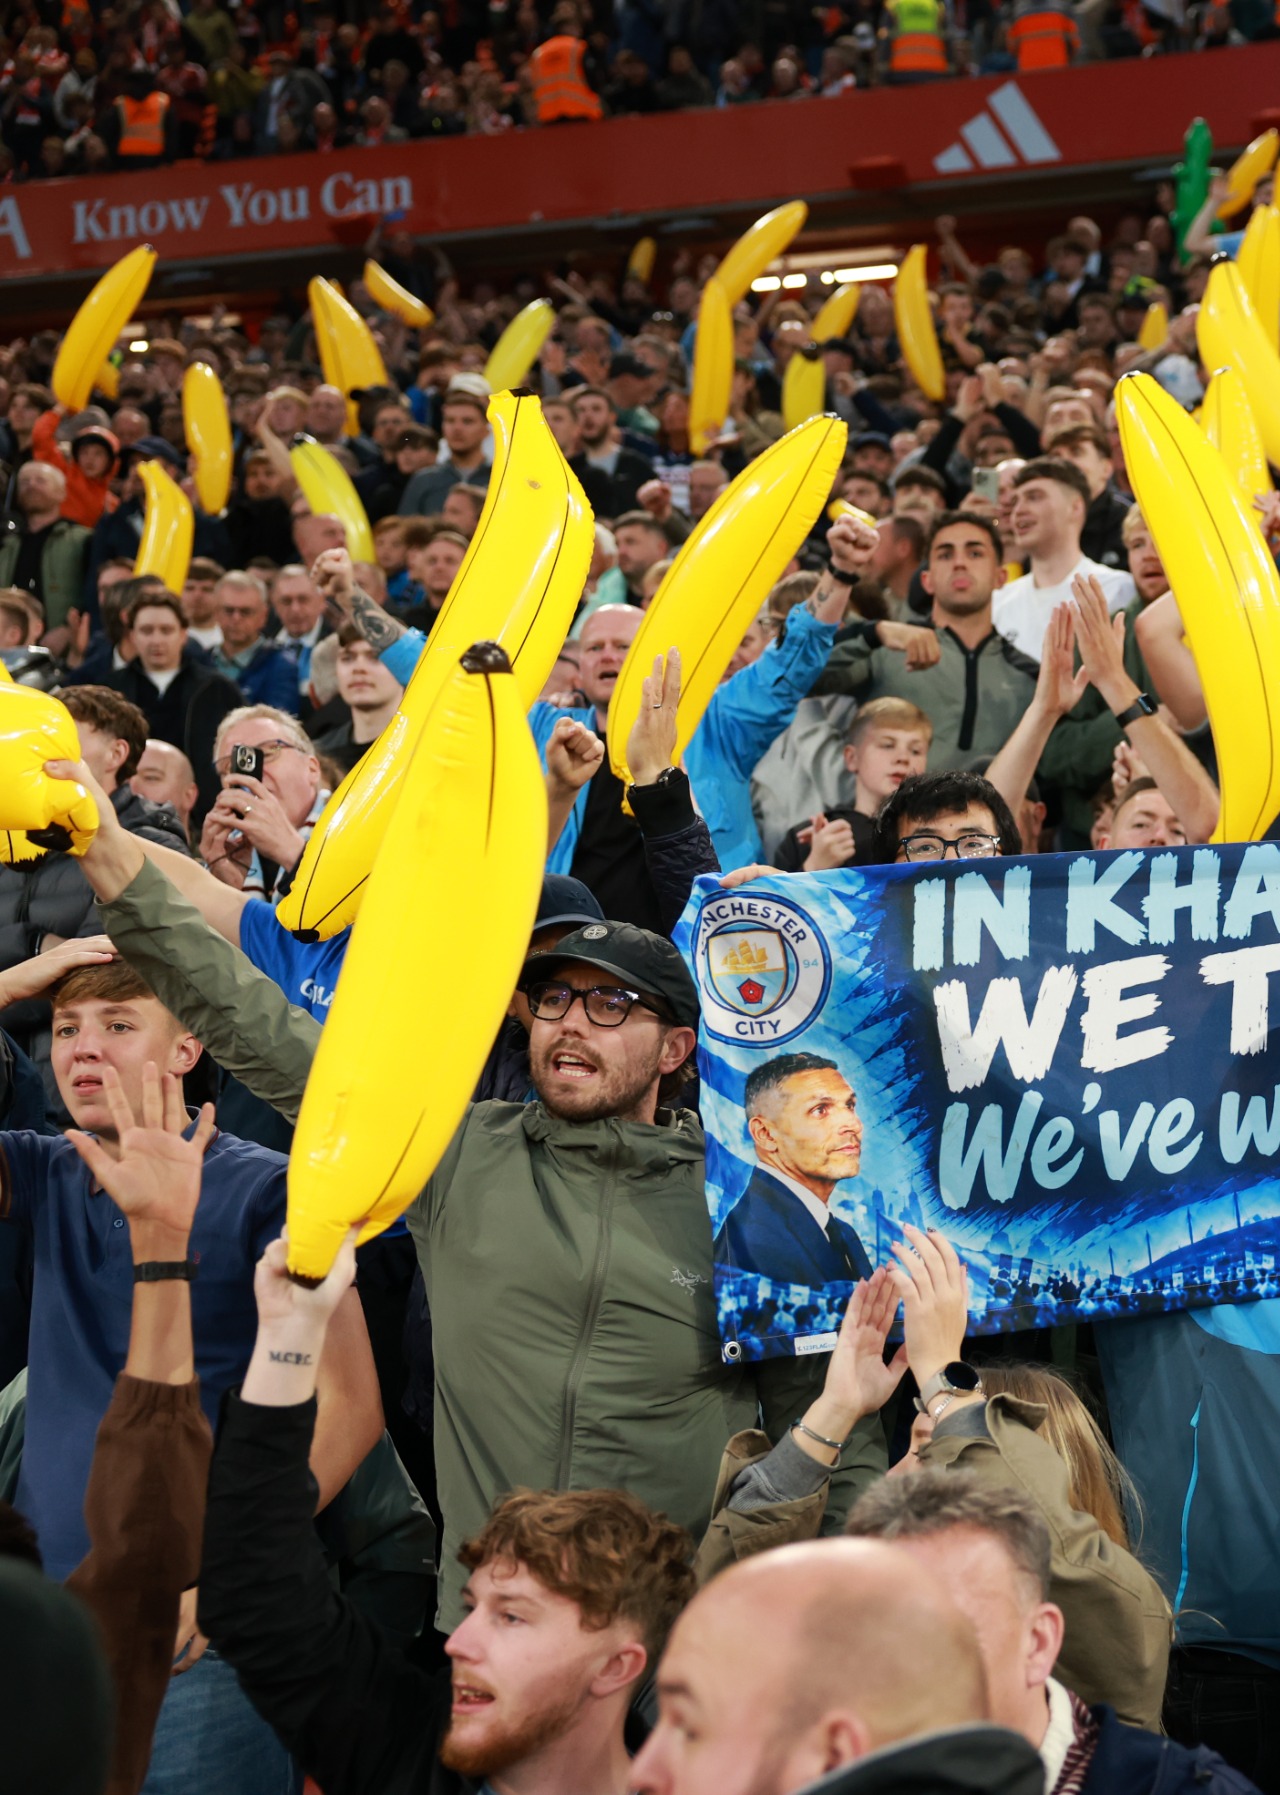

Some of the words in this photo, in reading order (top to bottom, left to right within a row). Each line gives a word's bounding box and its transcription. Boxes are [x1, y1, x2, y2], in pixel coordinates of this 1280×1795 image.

[72, 196, 210, 244] Know
[220, 182, 310, 227] You
[321, 172, 413, 218] Can
[913, 865, 1032, 971] IN
[735, 1019, 781, 1036] CITY
[933, 954, 1176, 1093] WE
[939, 1082, 1203, 1210] We've
